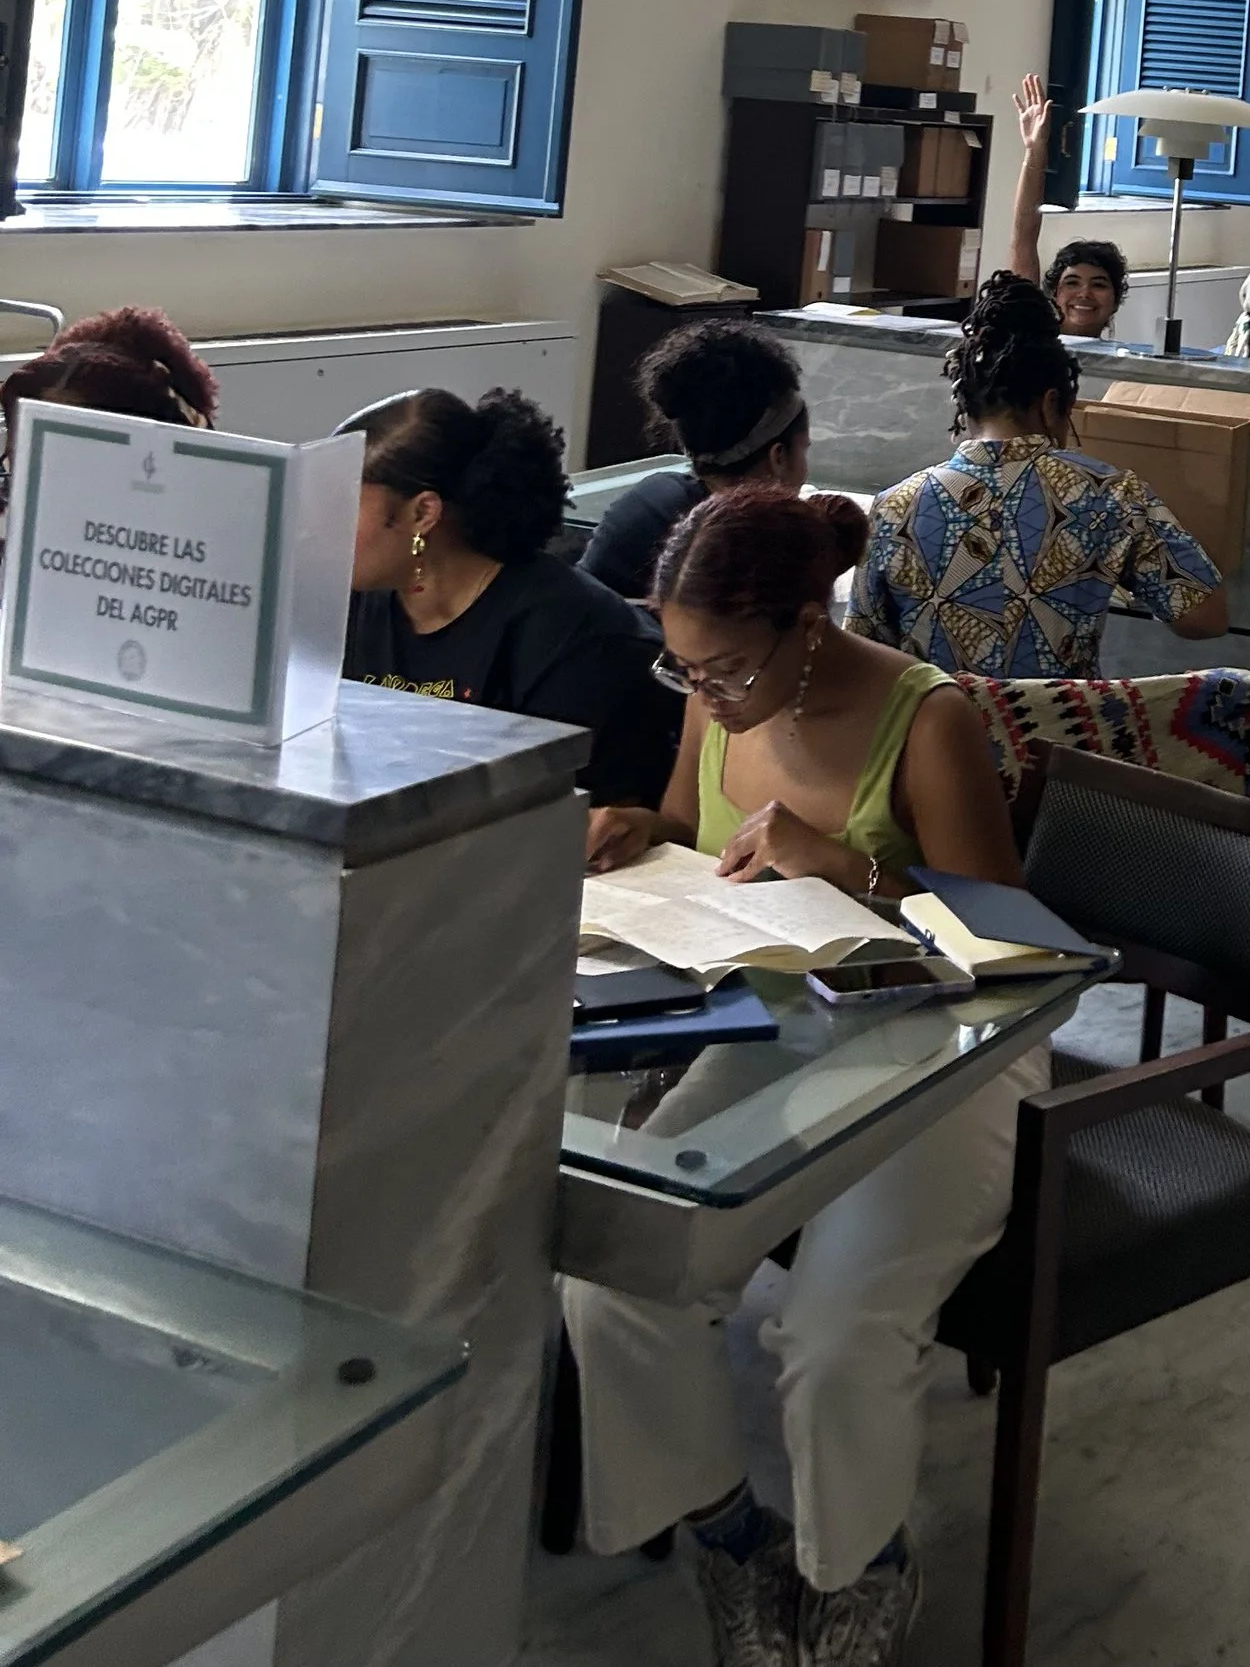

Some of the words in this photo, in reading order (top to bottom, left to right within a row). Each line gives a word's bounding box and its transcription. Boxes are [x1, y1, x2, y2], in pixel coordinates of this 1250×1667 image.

[83, 520, 169, 556] DESCUBRE
[173, 537, 206, 563] LAS
[39, 548, 155, 591] COLECCIONES
[159, 571, 252, 607] DIGITALES
[96, 594, 125, 621] DEL
[129, 603, 179, 632] AGPR
